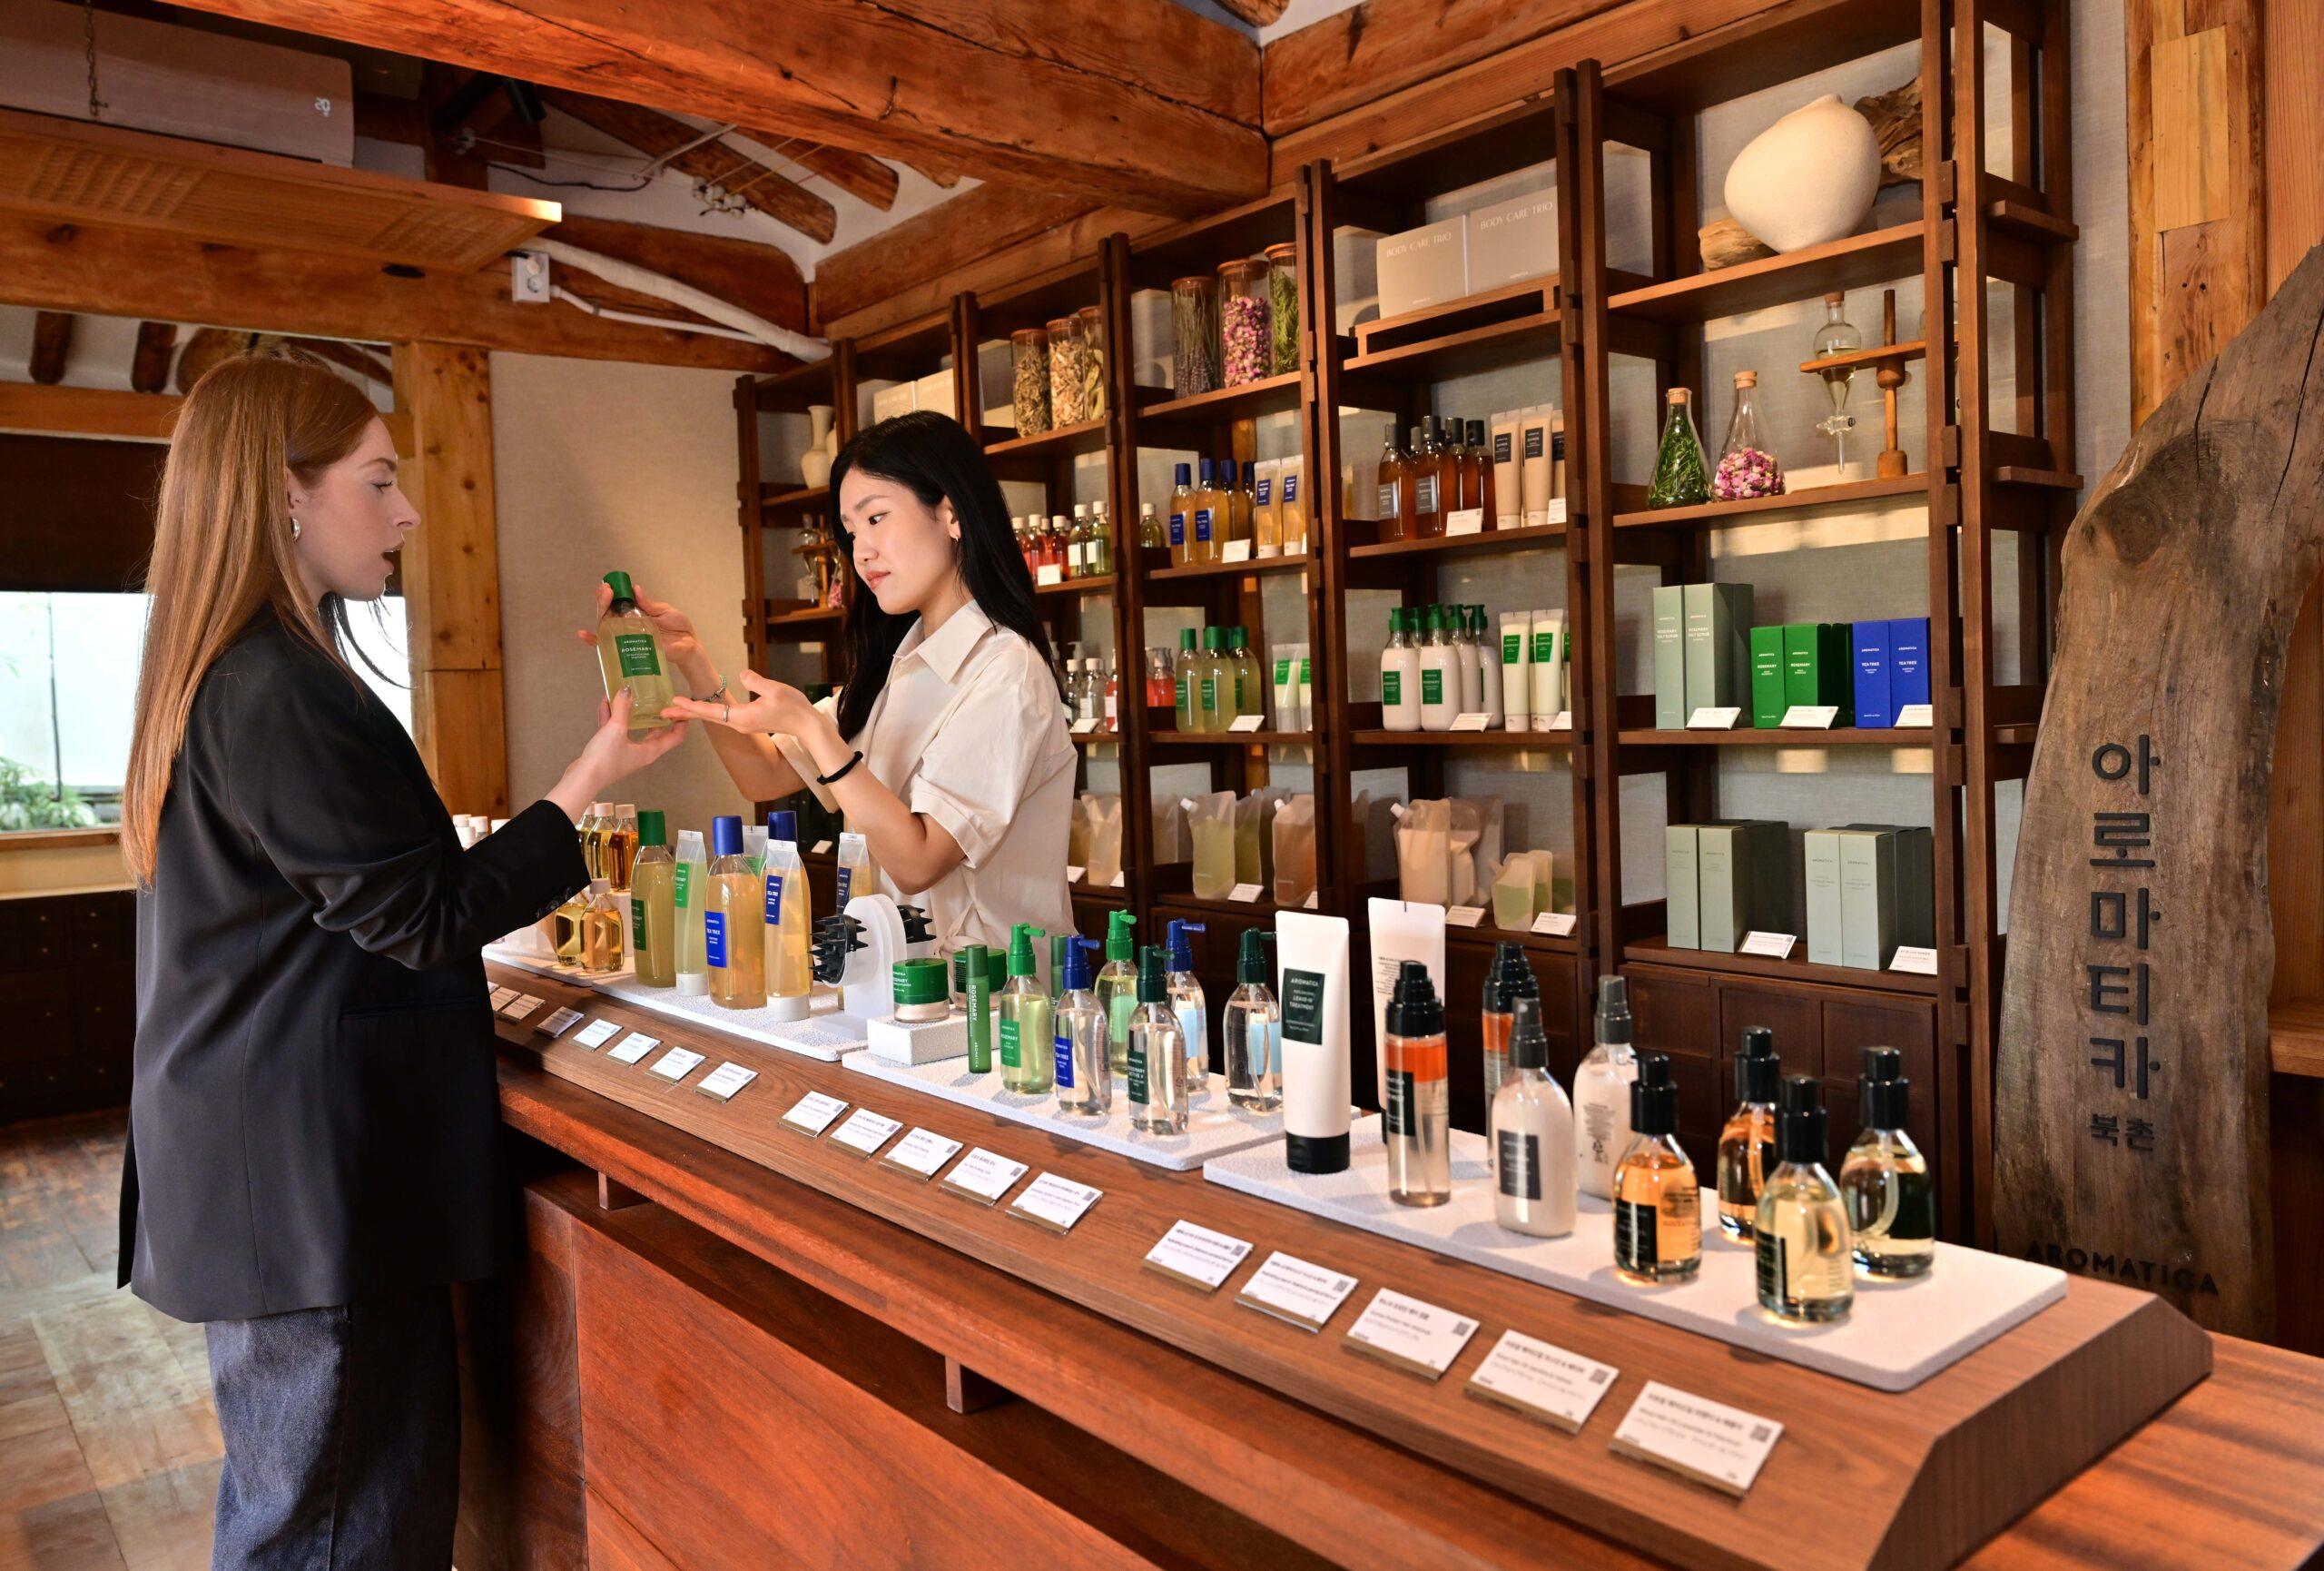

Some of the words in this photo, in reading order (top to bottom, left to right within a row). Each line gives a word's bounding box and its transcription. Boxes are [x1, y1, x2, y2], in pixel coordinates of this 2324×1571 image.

[1481, 216, 1503, 230] BODY
[1506, 209, 1529, 222] CARE
[1532, 202, 1554, 214] TRIO
[1386, 244, 1408, 258] BODY
[1409, 238, 1431, 251] CARE
[1433, 232, 1452, 244] TRIO
[2088, 734, 2161, 1100] 아로마티카
[1290, 977, 1319, 988] AROMATICA
[2090, 1112, 2155, 1151] 북촌
[2024, 1240, 2219, 1297] AROMATICA
